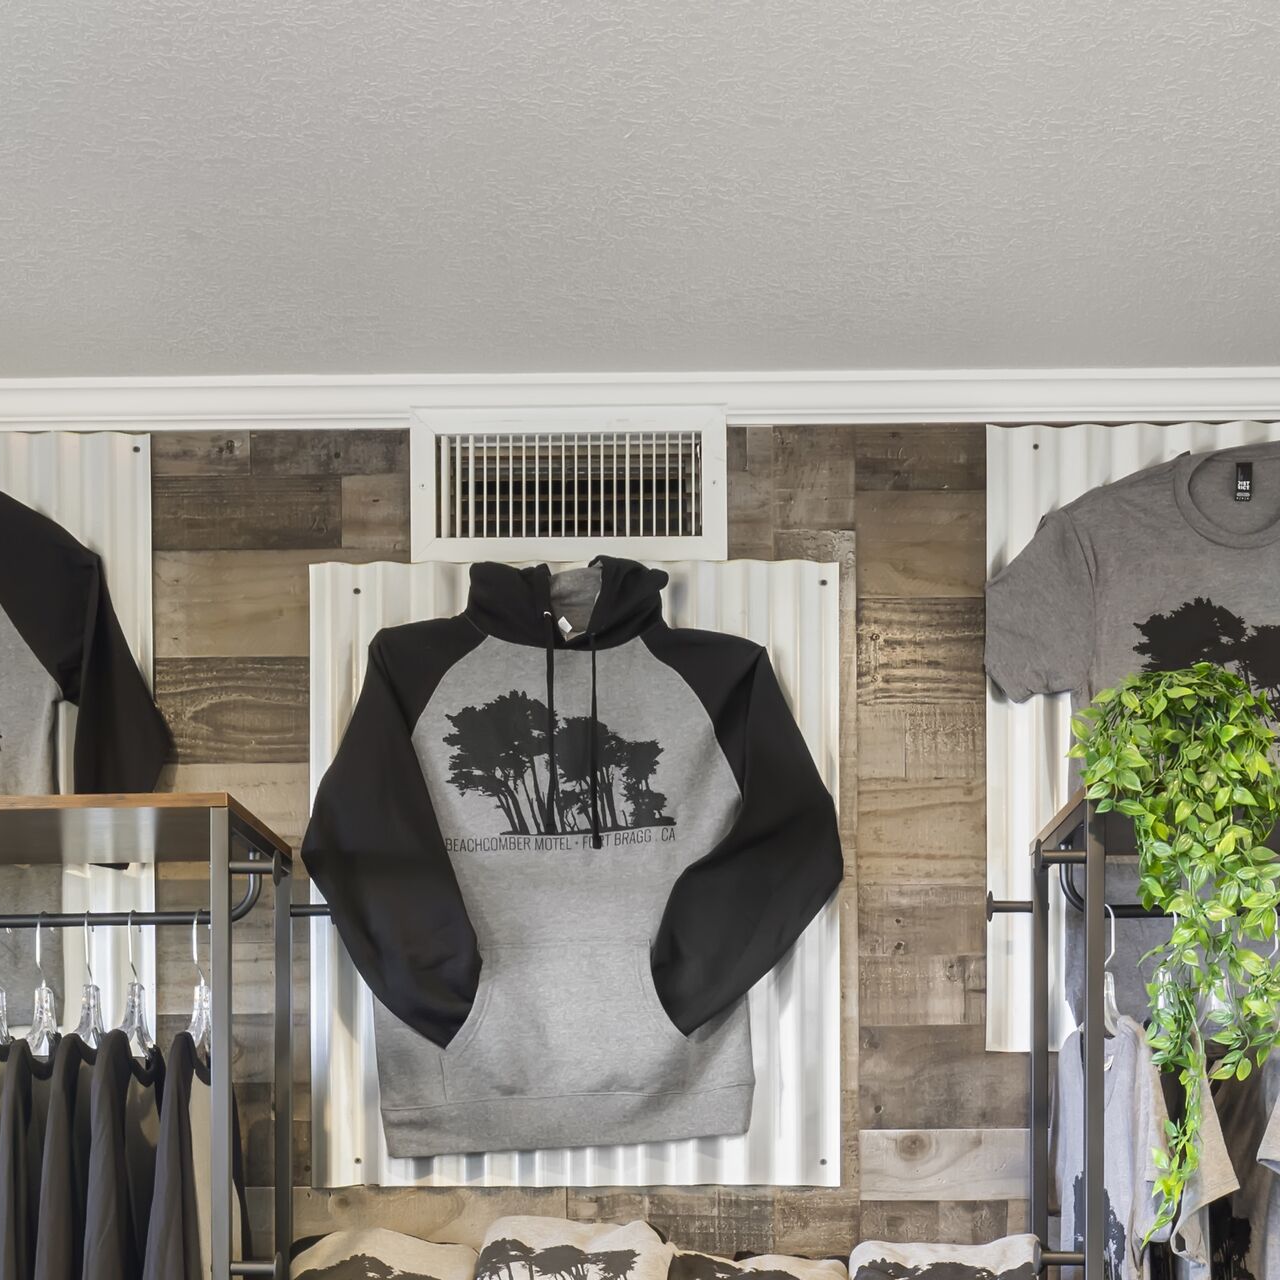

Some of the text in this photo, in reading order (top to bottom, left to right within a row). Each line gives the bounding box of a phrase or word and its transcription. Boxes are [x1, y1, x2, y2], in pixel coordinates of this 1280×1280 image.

[445, 838, 531, 852] BEACHCOMBER
[535, 837, 571, 850] MOTEL
[614, 828, 651, 846] BRAGG
[661, 827, 676, 841] CA
